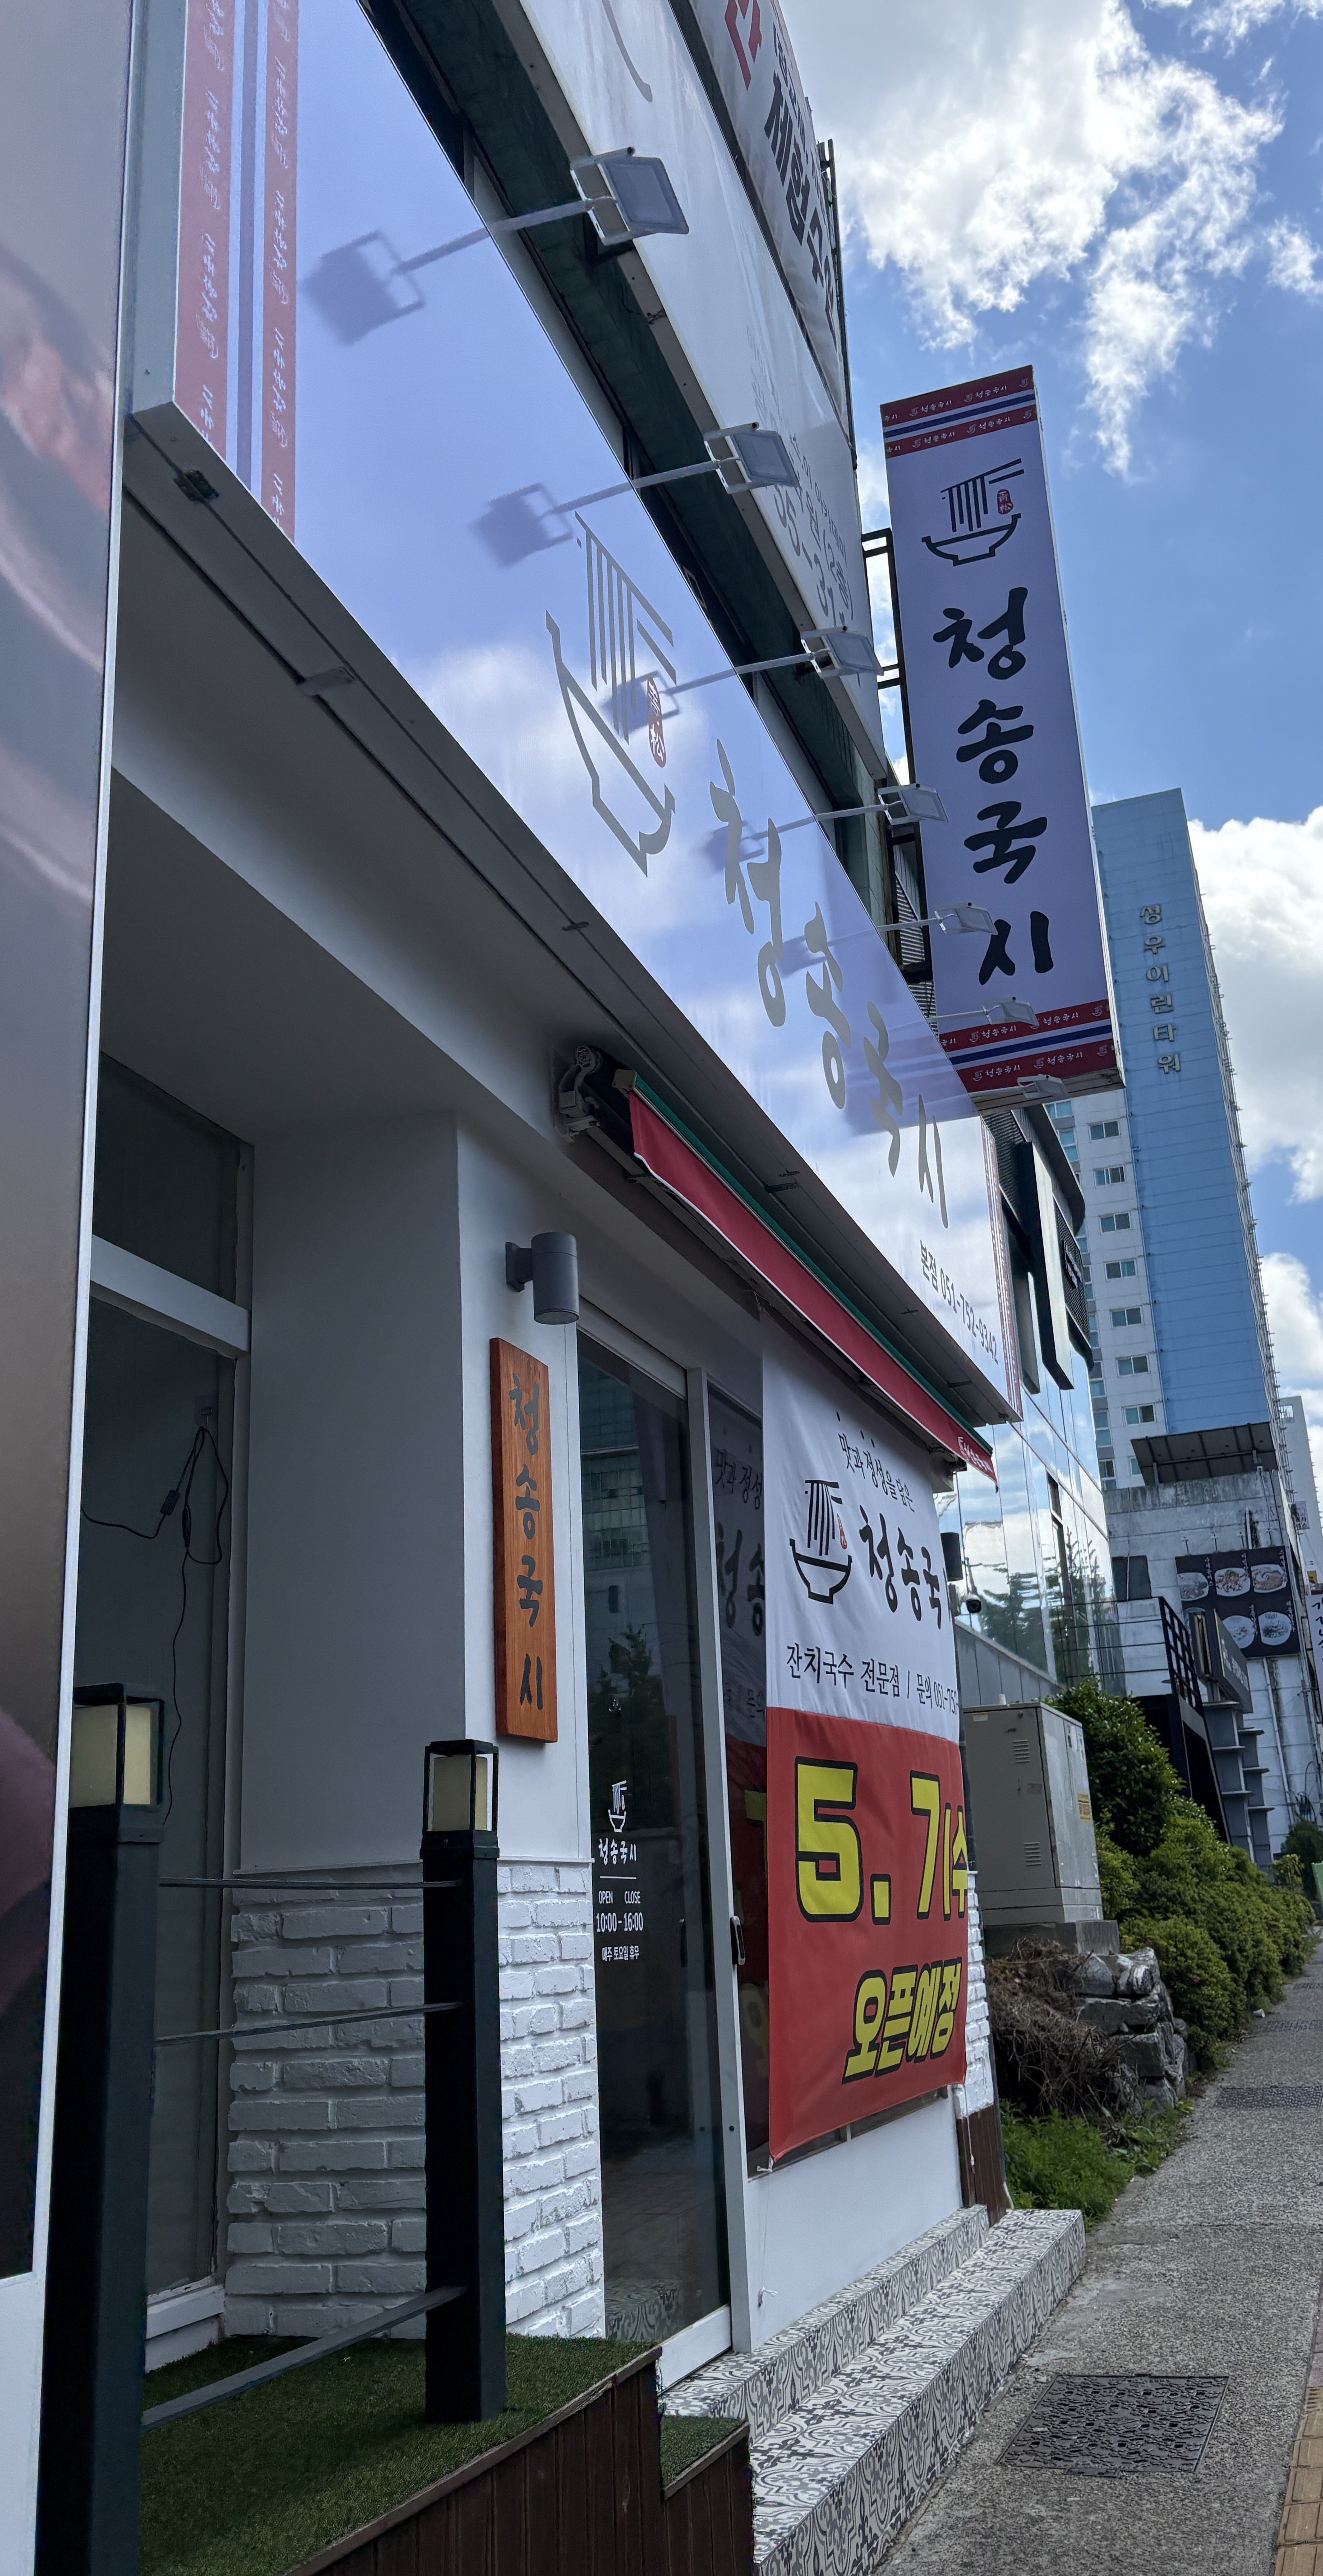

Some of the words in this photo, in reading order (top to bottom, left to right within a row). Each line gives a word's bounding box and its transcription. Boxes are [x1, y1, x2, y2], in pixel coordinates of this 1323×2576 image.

[933, 587, 1054, 985] 청송국시
[710, 739, 948, 1228] 청송국시
[982, 1025, 1016, 1039] 청송국시
[1042, 1012, 1079, 1026] 청송국시
[985, 1065, 1020, 1077] 청송국시
[1046, 1052, 1083, 1065] 청송국시
[920, 1239, 939, 1293] 본점
[940, 1268, 999, 1365] 051-752-9342
[838, 1433, 866, 1479] 맛과
[863, 1450, 898, 1500] 정성을
[895, 1478, 915, 1513] 담은
[508, 1373, 543, 1711] 청송국시
[859, 1505, 950, 1630] 청송국
[786, 1642, 854, 1689] 잔치국수
[860, 1658, 900, 1698] 전문점
[916, 1673, 933, 1709] 문의
[599, 1838, 637, 1865] 청송국시
[599, 1891, 613, 1904] OPEN
[624, 1891, 641, 1904] CLOSE
[602, 1947, 613, 1961] 매주
[614, 1946, 628, 1960] 토요일
[629, 1945, 640, 1960] 휴무
[841, 1956, 963, 2084] 오픈예정
